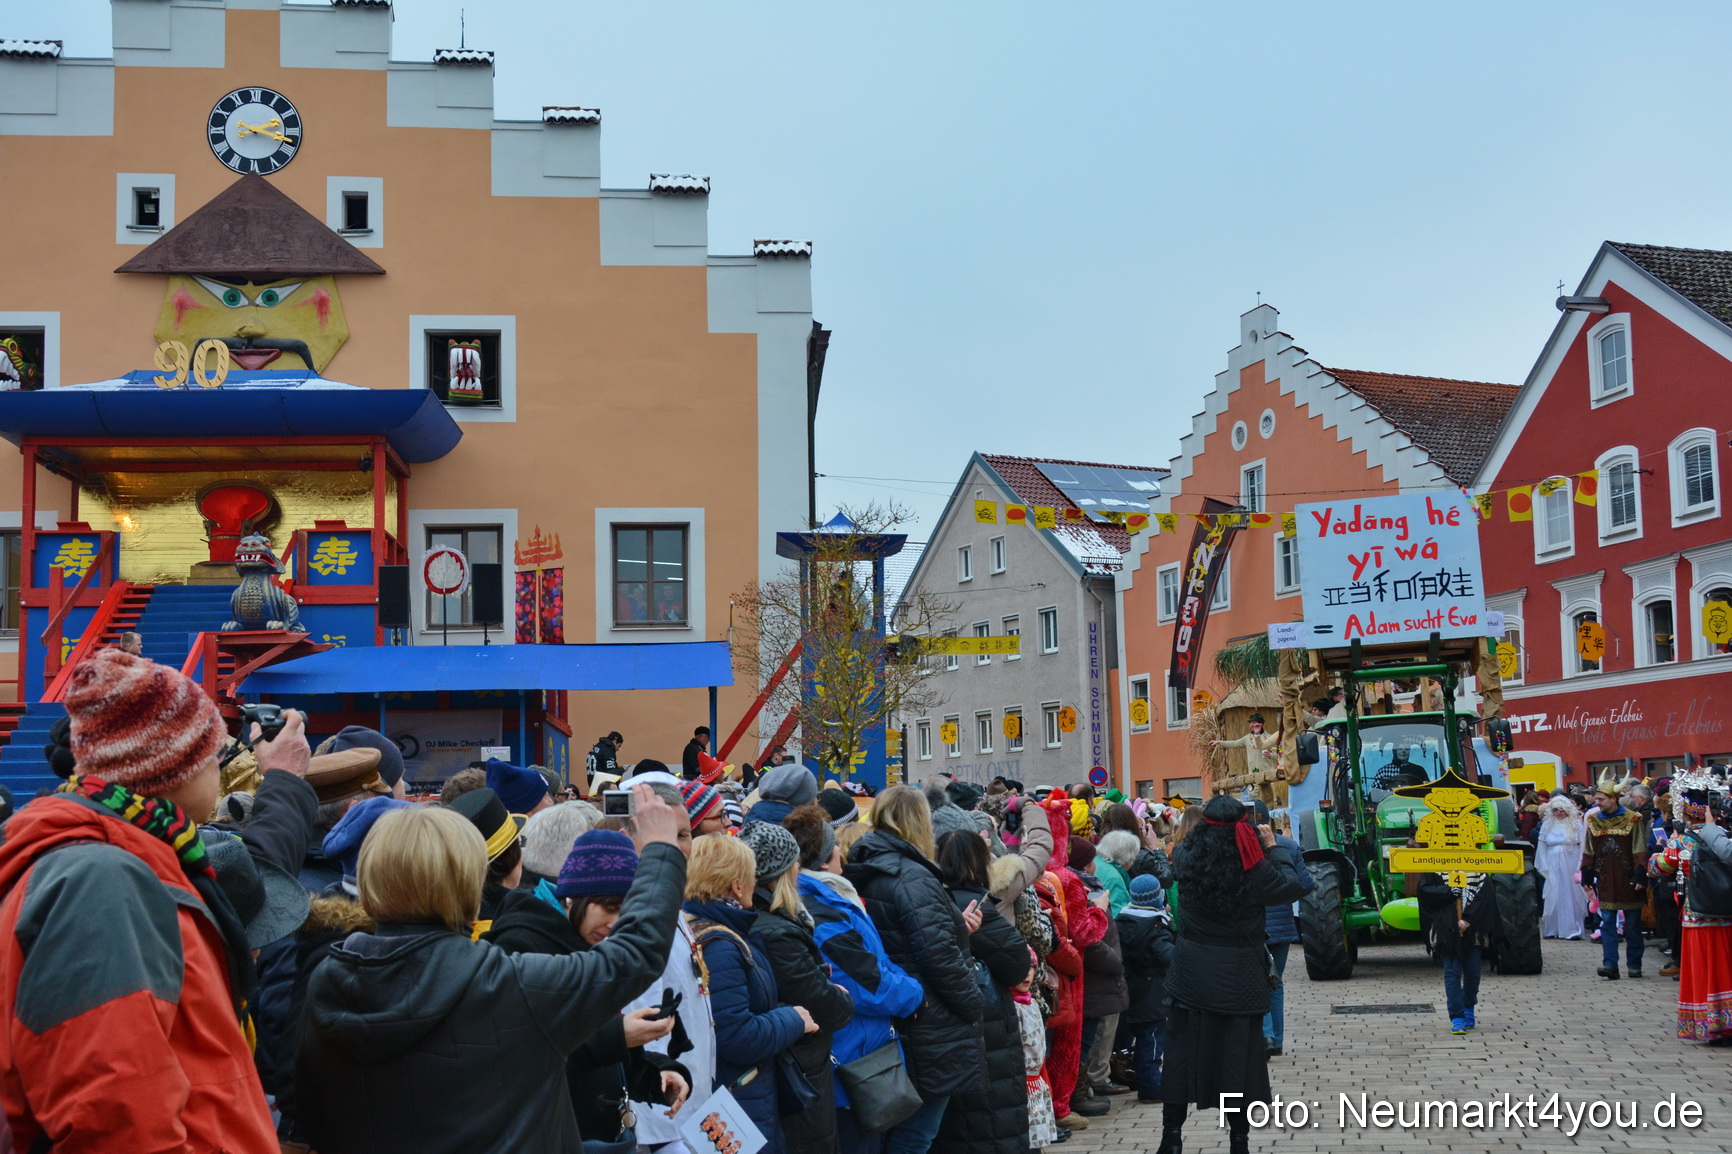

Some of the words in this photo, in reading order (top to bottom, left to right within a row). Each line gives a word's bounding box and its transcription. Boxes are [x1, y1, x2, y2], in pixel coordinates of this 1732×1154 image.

[153, 339, 230, 389] 90
[1426, 496, 1461, 526] hé
[1394, 537, 1439, 561] wá
[1343, 610, 1401, 640] Adam
[1403, 608, 1445, 631] sucht
[1447, 606, 1477, 626] Eva
[1089, 623, 1099, 679] UHREN
[1091, 687, 1101, 766] SCHMUCK
[1502, 713, 1552, 734] ÖTZ.
[1554, 706, 1579, 731] Mode
[1580, 711, 1607, 734] Genuss
[1610, 699, 1643, 723] Erlebnis
[1663, 696, 1723, 737] Erlebnis
[438, 740, 458, 748] Mike
[460, 738, 495, 747] Checkoff
[946, 763, 984, 784] OPTIK
[1412, 856, 1462, 866] Landjugend
[1464, 856, 1504, 866] Vogelthal
[1453, 874, 1462, 886] 4
